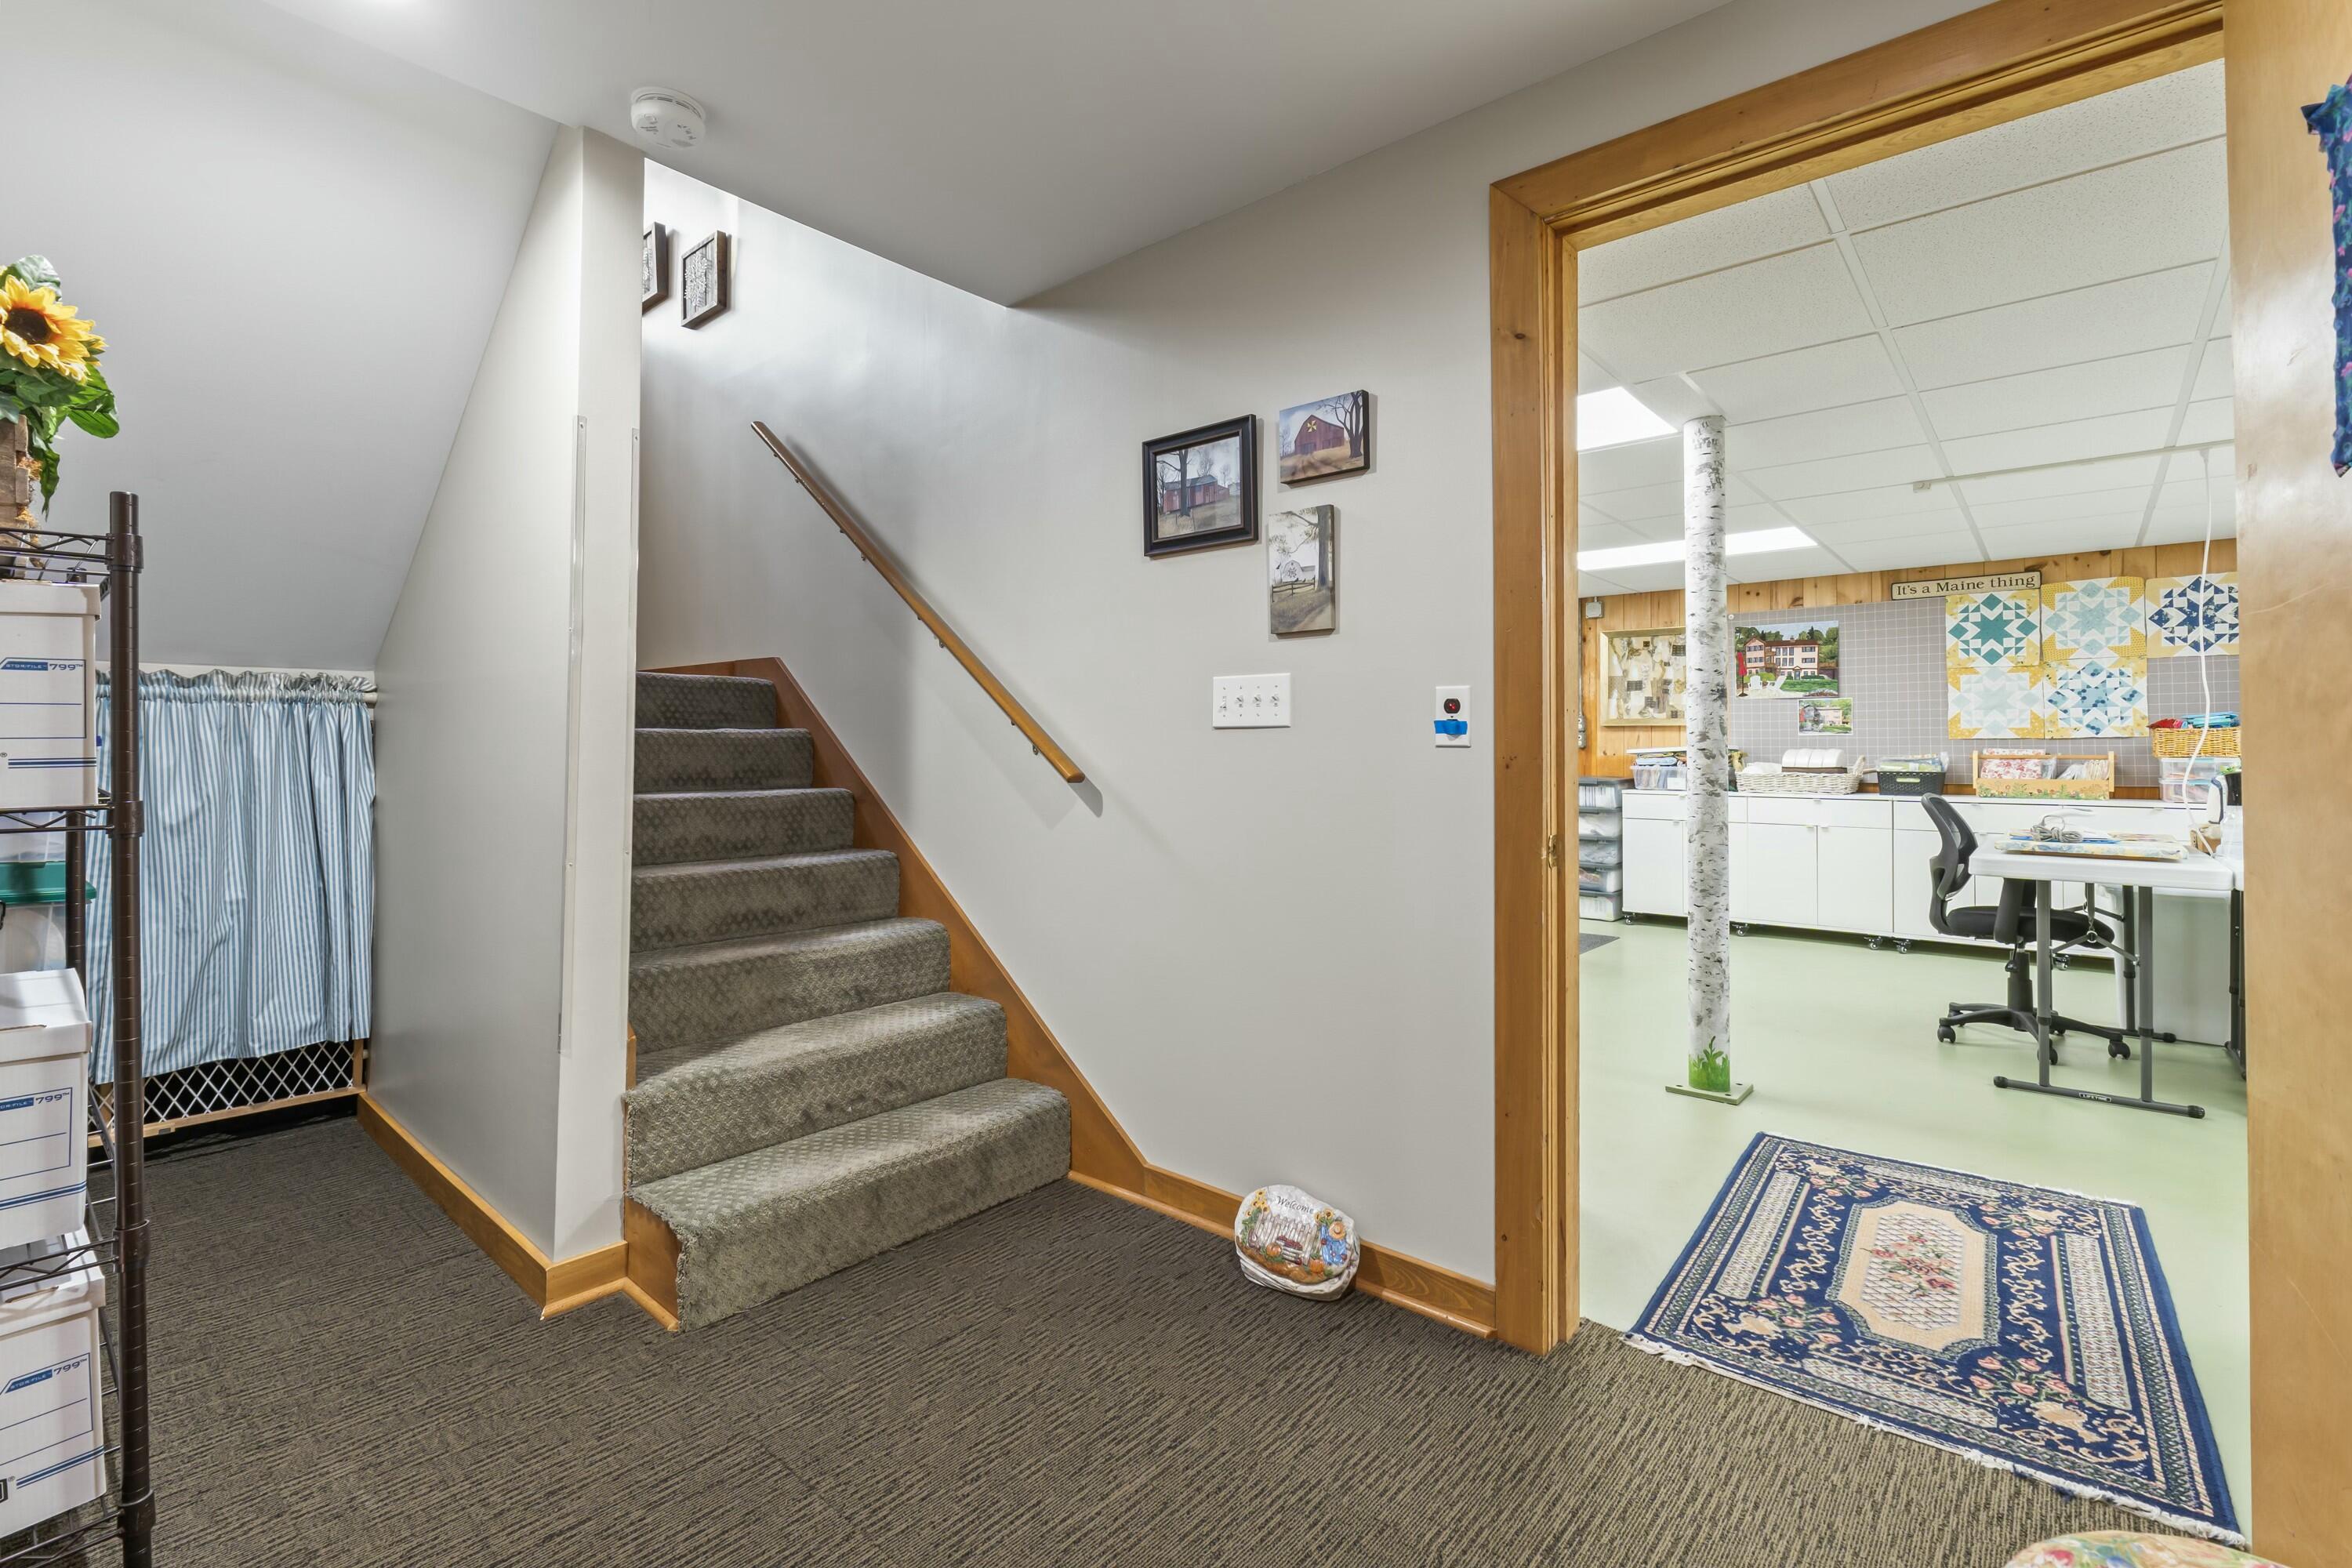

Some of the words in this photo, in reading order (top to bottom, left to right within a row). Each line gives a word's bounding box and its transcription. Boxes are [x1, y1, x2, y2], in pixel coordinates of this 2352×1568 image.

[1896, 585, 1917, 596] It's
[1936, 580, 1985, 593] Maine
[1990, 575, 2036, 588] thing
[1277, 1195, 1314, 1214] Welcome
